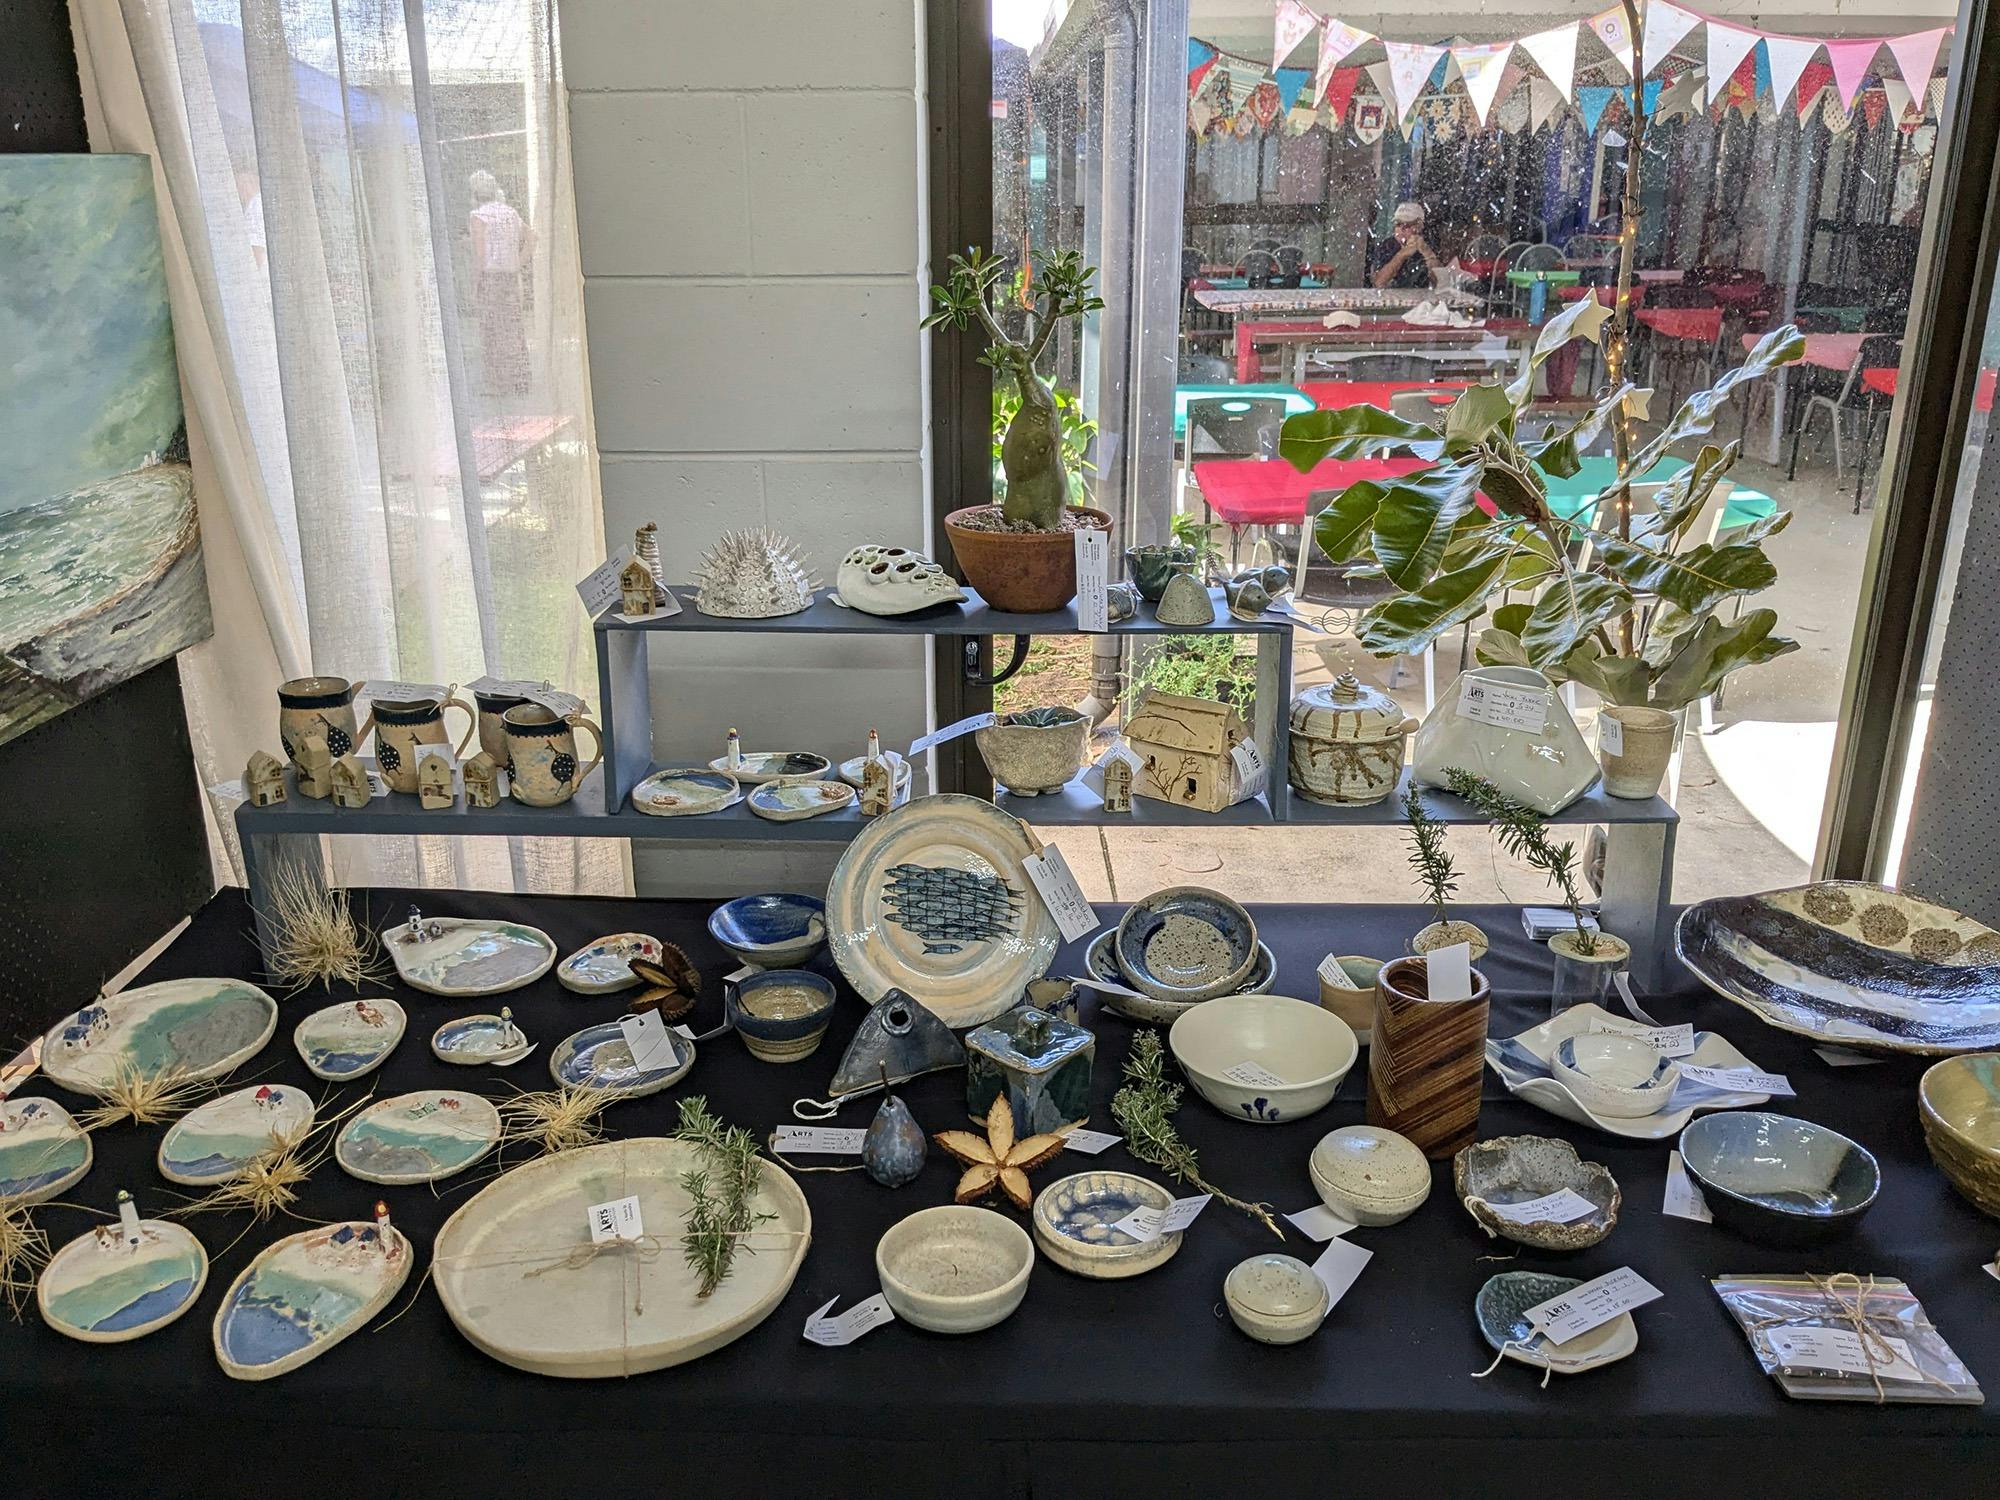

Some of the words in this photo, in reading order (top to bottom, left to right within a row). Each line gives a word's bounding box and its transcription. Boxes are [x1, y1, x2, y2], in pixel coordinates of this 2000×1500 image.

[1467, 686, 1485, 698] ARTS
[599, 1207, 615, 1235] ARTS
[1544, 1302, 1572, 1321] ARTS
